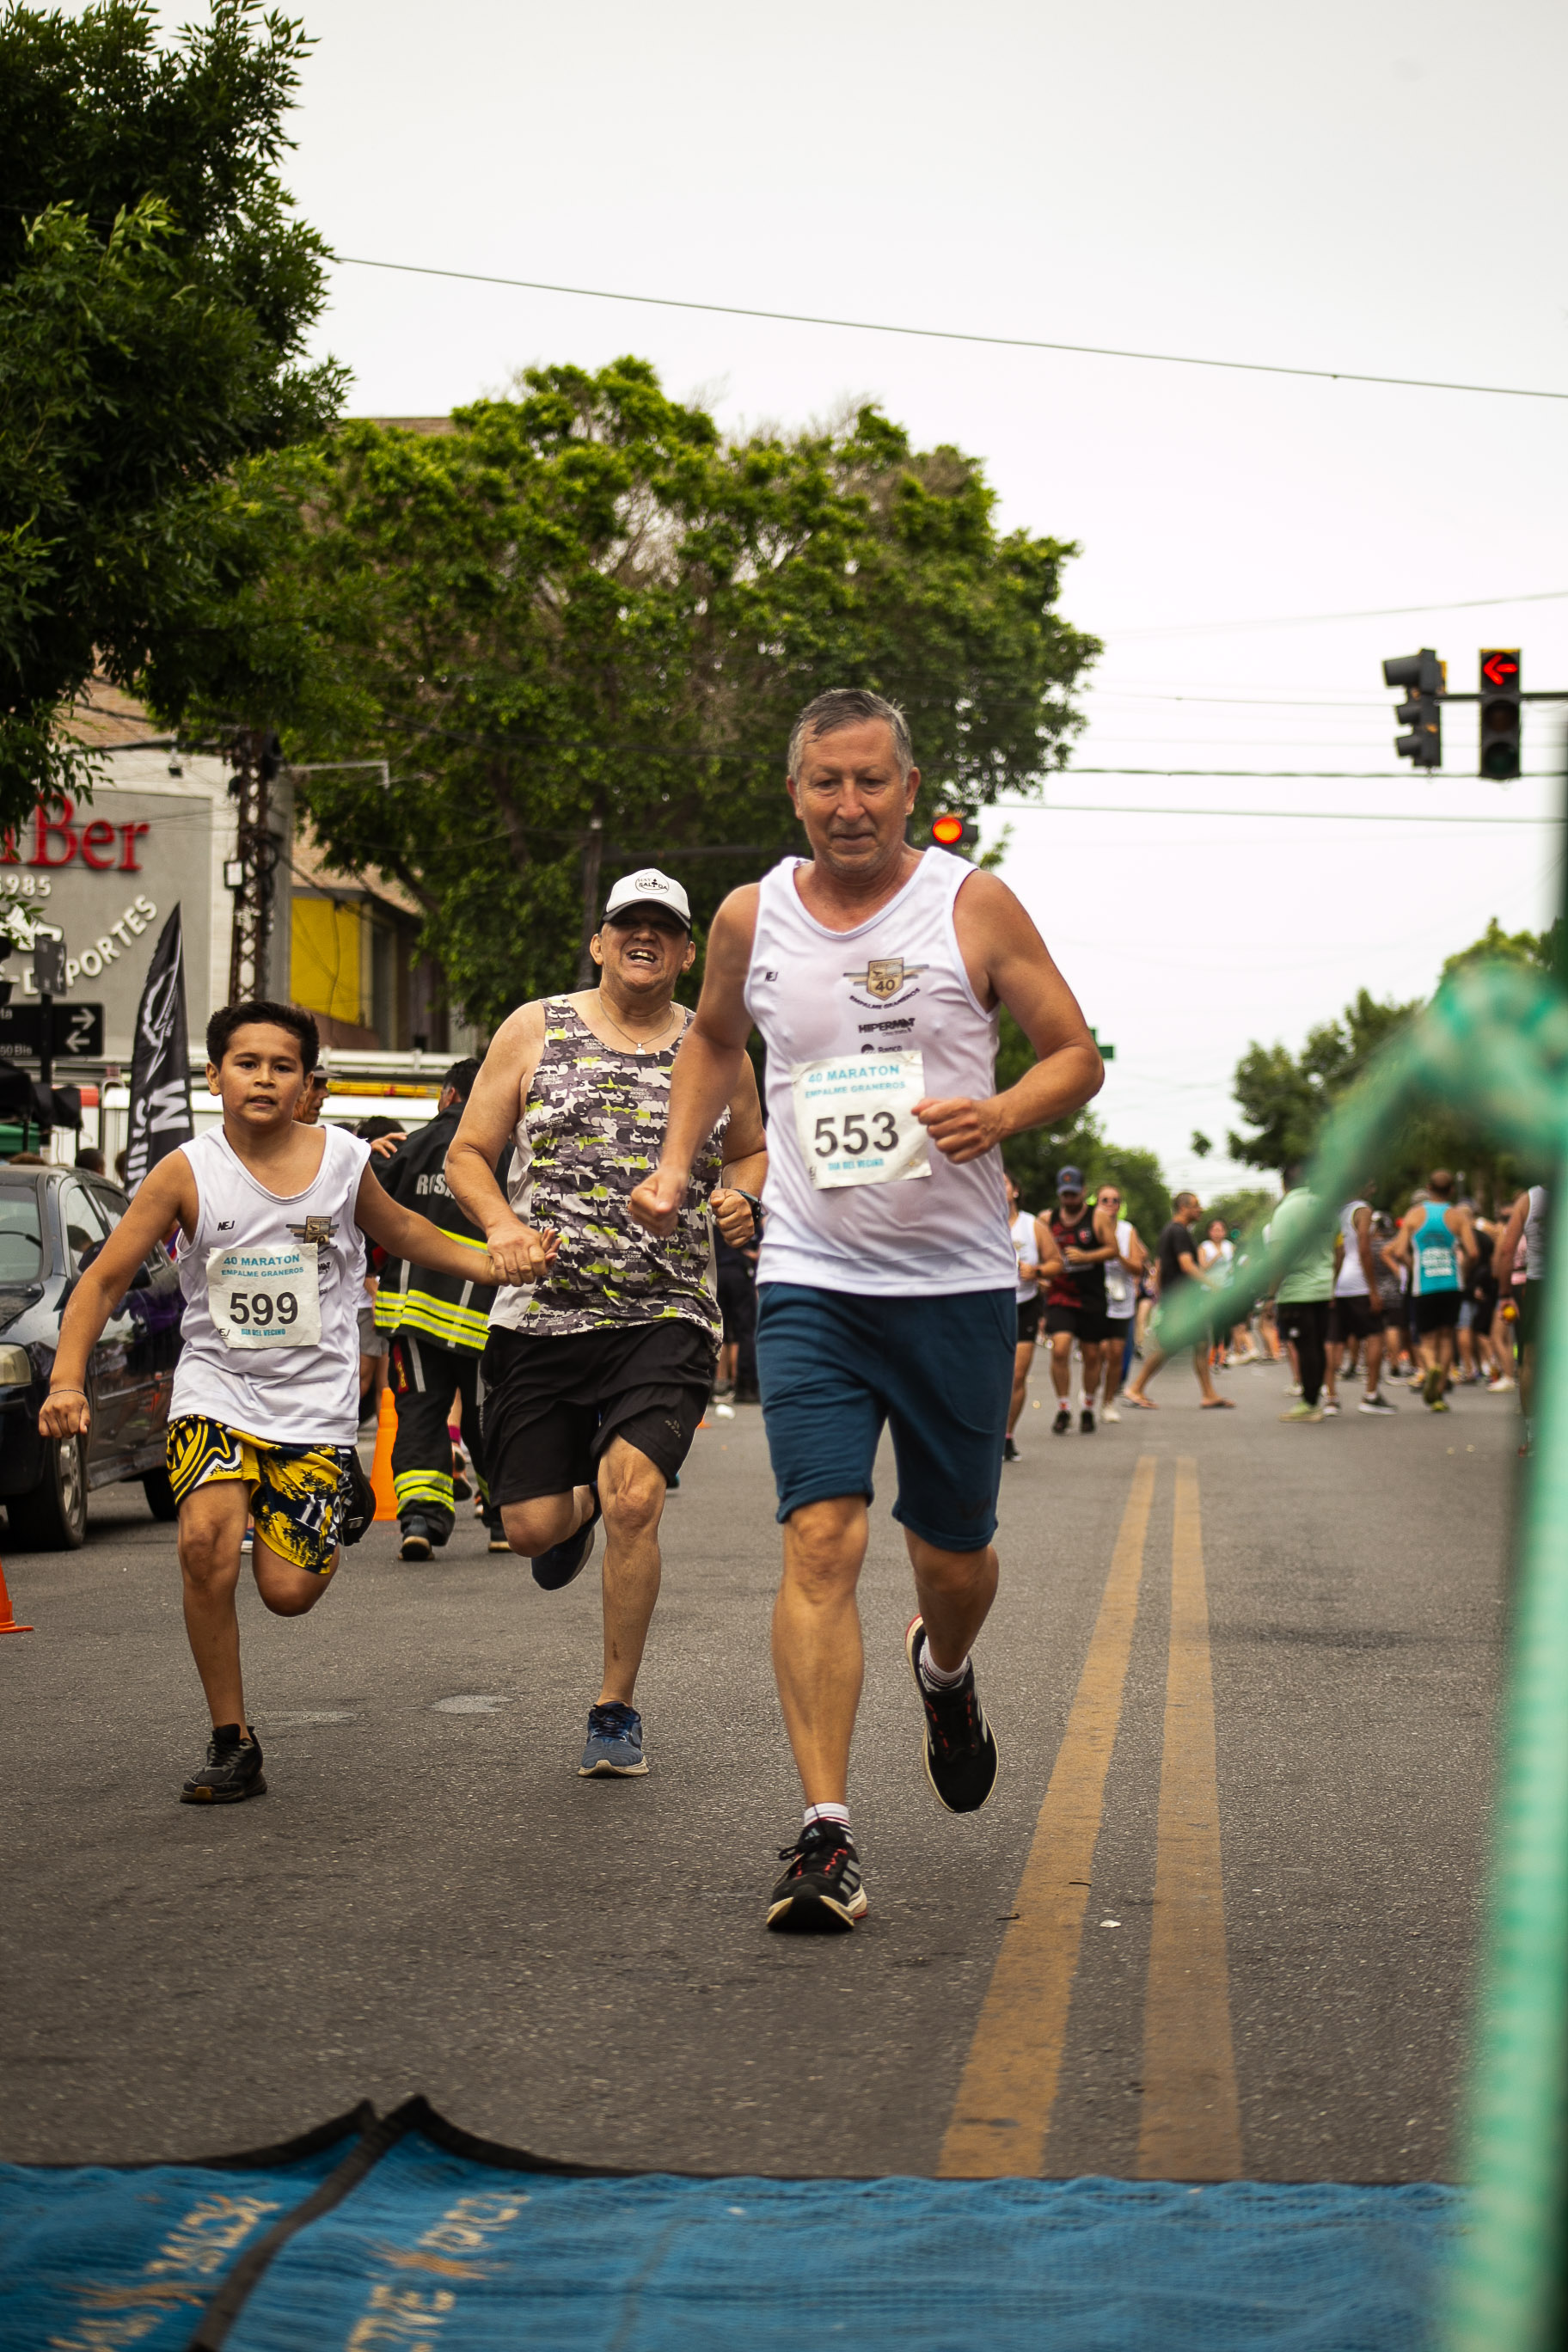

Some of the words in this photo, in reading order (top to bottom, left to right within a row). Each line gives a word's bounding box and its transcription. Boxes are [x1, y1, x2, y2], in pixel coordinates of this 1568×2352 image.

[0, 873, 52, 897] 985
[875, 979, 896, 992] 40
[808, 1073, 823, 1083] 40
[827, 1064, 900, 1081] MARATON
[805, 1087, 848, 1099] EMPALME
[851, 1081, 906, 1093] GRANEROS
[815, 1111, 899, 1157] 553
[242, 1254, 300, 1266] MARATON
[221, 1269, 259, 1277] EMPALME
[261, 1267, 303, 1277] GRANEROS
[230, 1292, 298, 1326] 599
